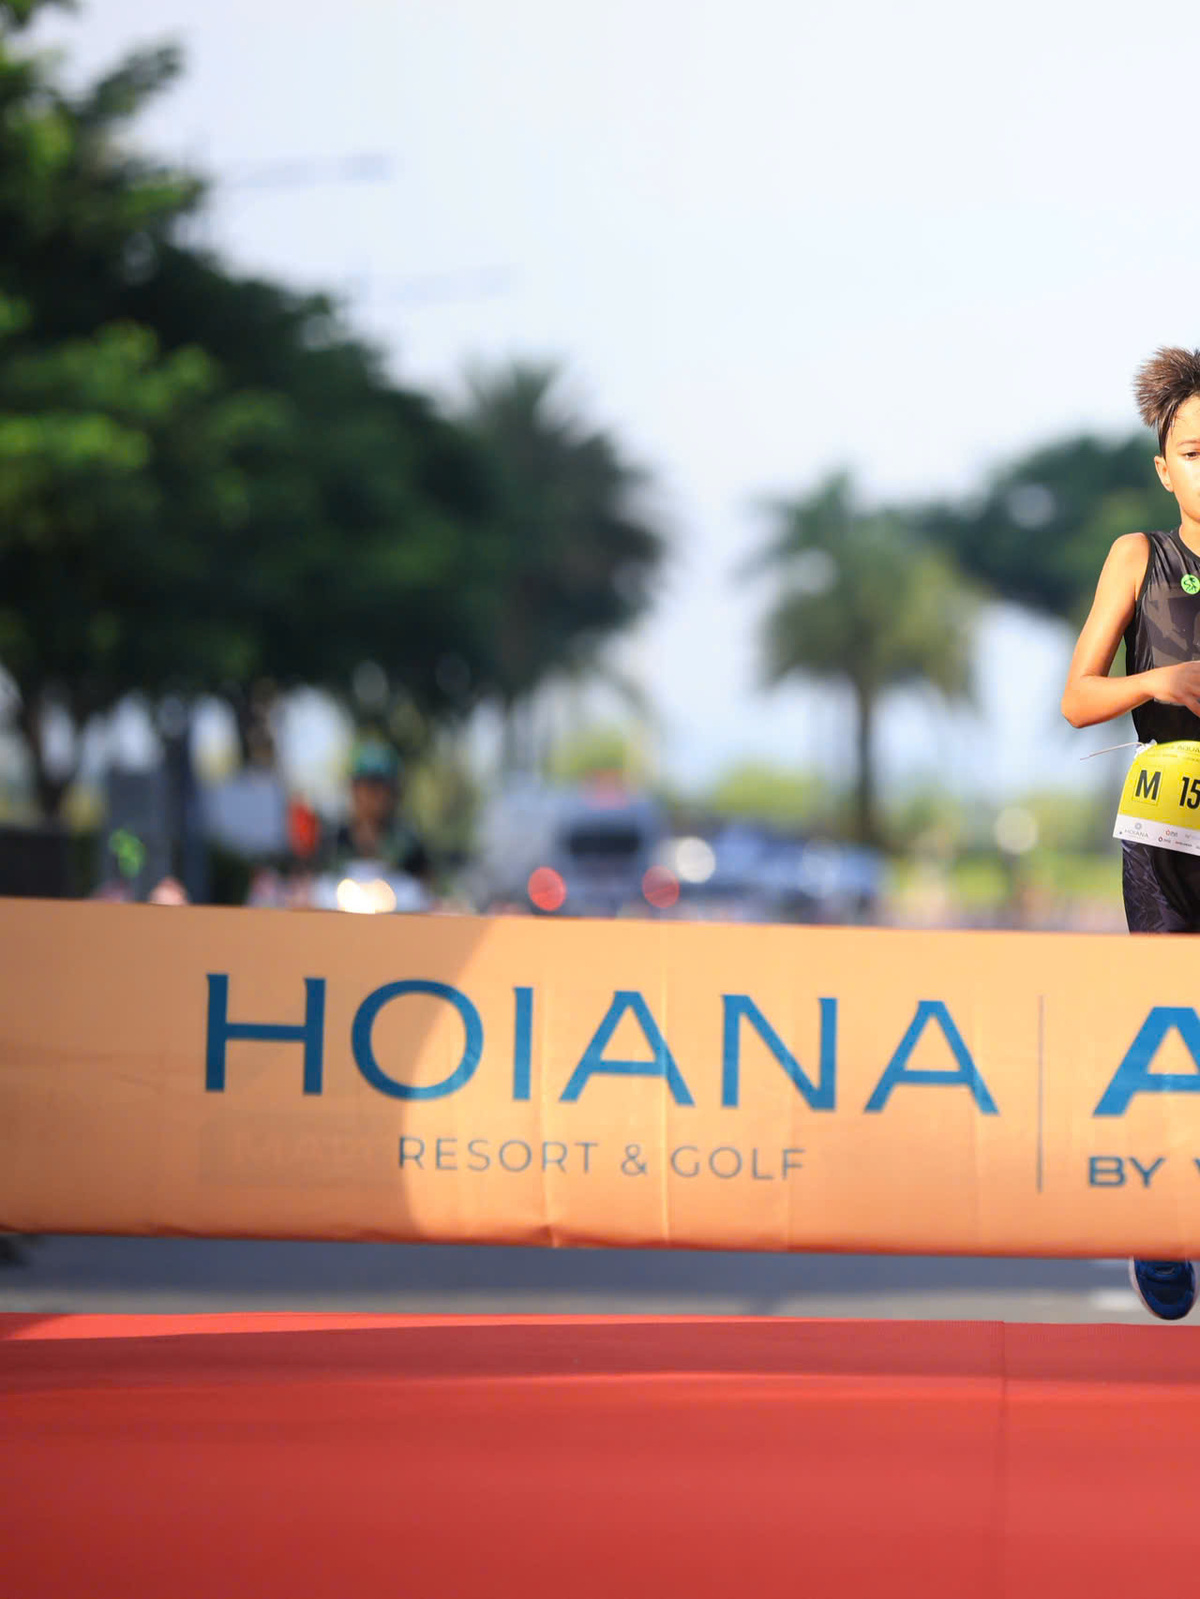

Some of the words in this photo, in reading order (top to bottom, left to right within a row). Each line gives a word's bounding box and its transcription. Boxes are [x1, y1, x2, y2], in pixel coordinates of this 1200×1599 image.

[1134, 769, 1161, 801] M
[204, 972, 999, 1115] HOIANA
[397, 1135, 601, 1174] RESORT
[620, 1141, 649, 1177] &
[670, 1143, 806, 1181] GOLF
[1087, 1155, 1166, 1189] BY
